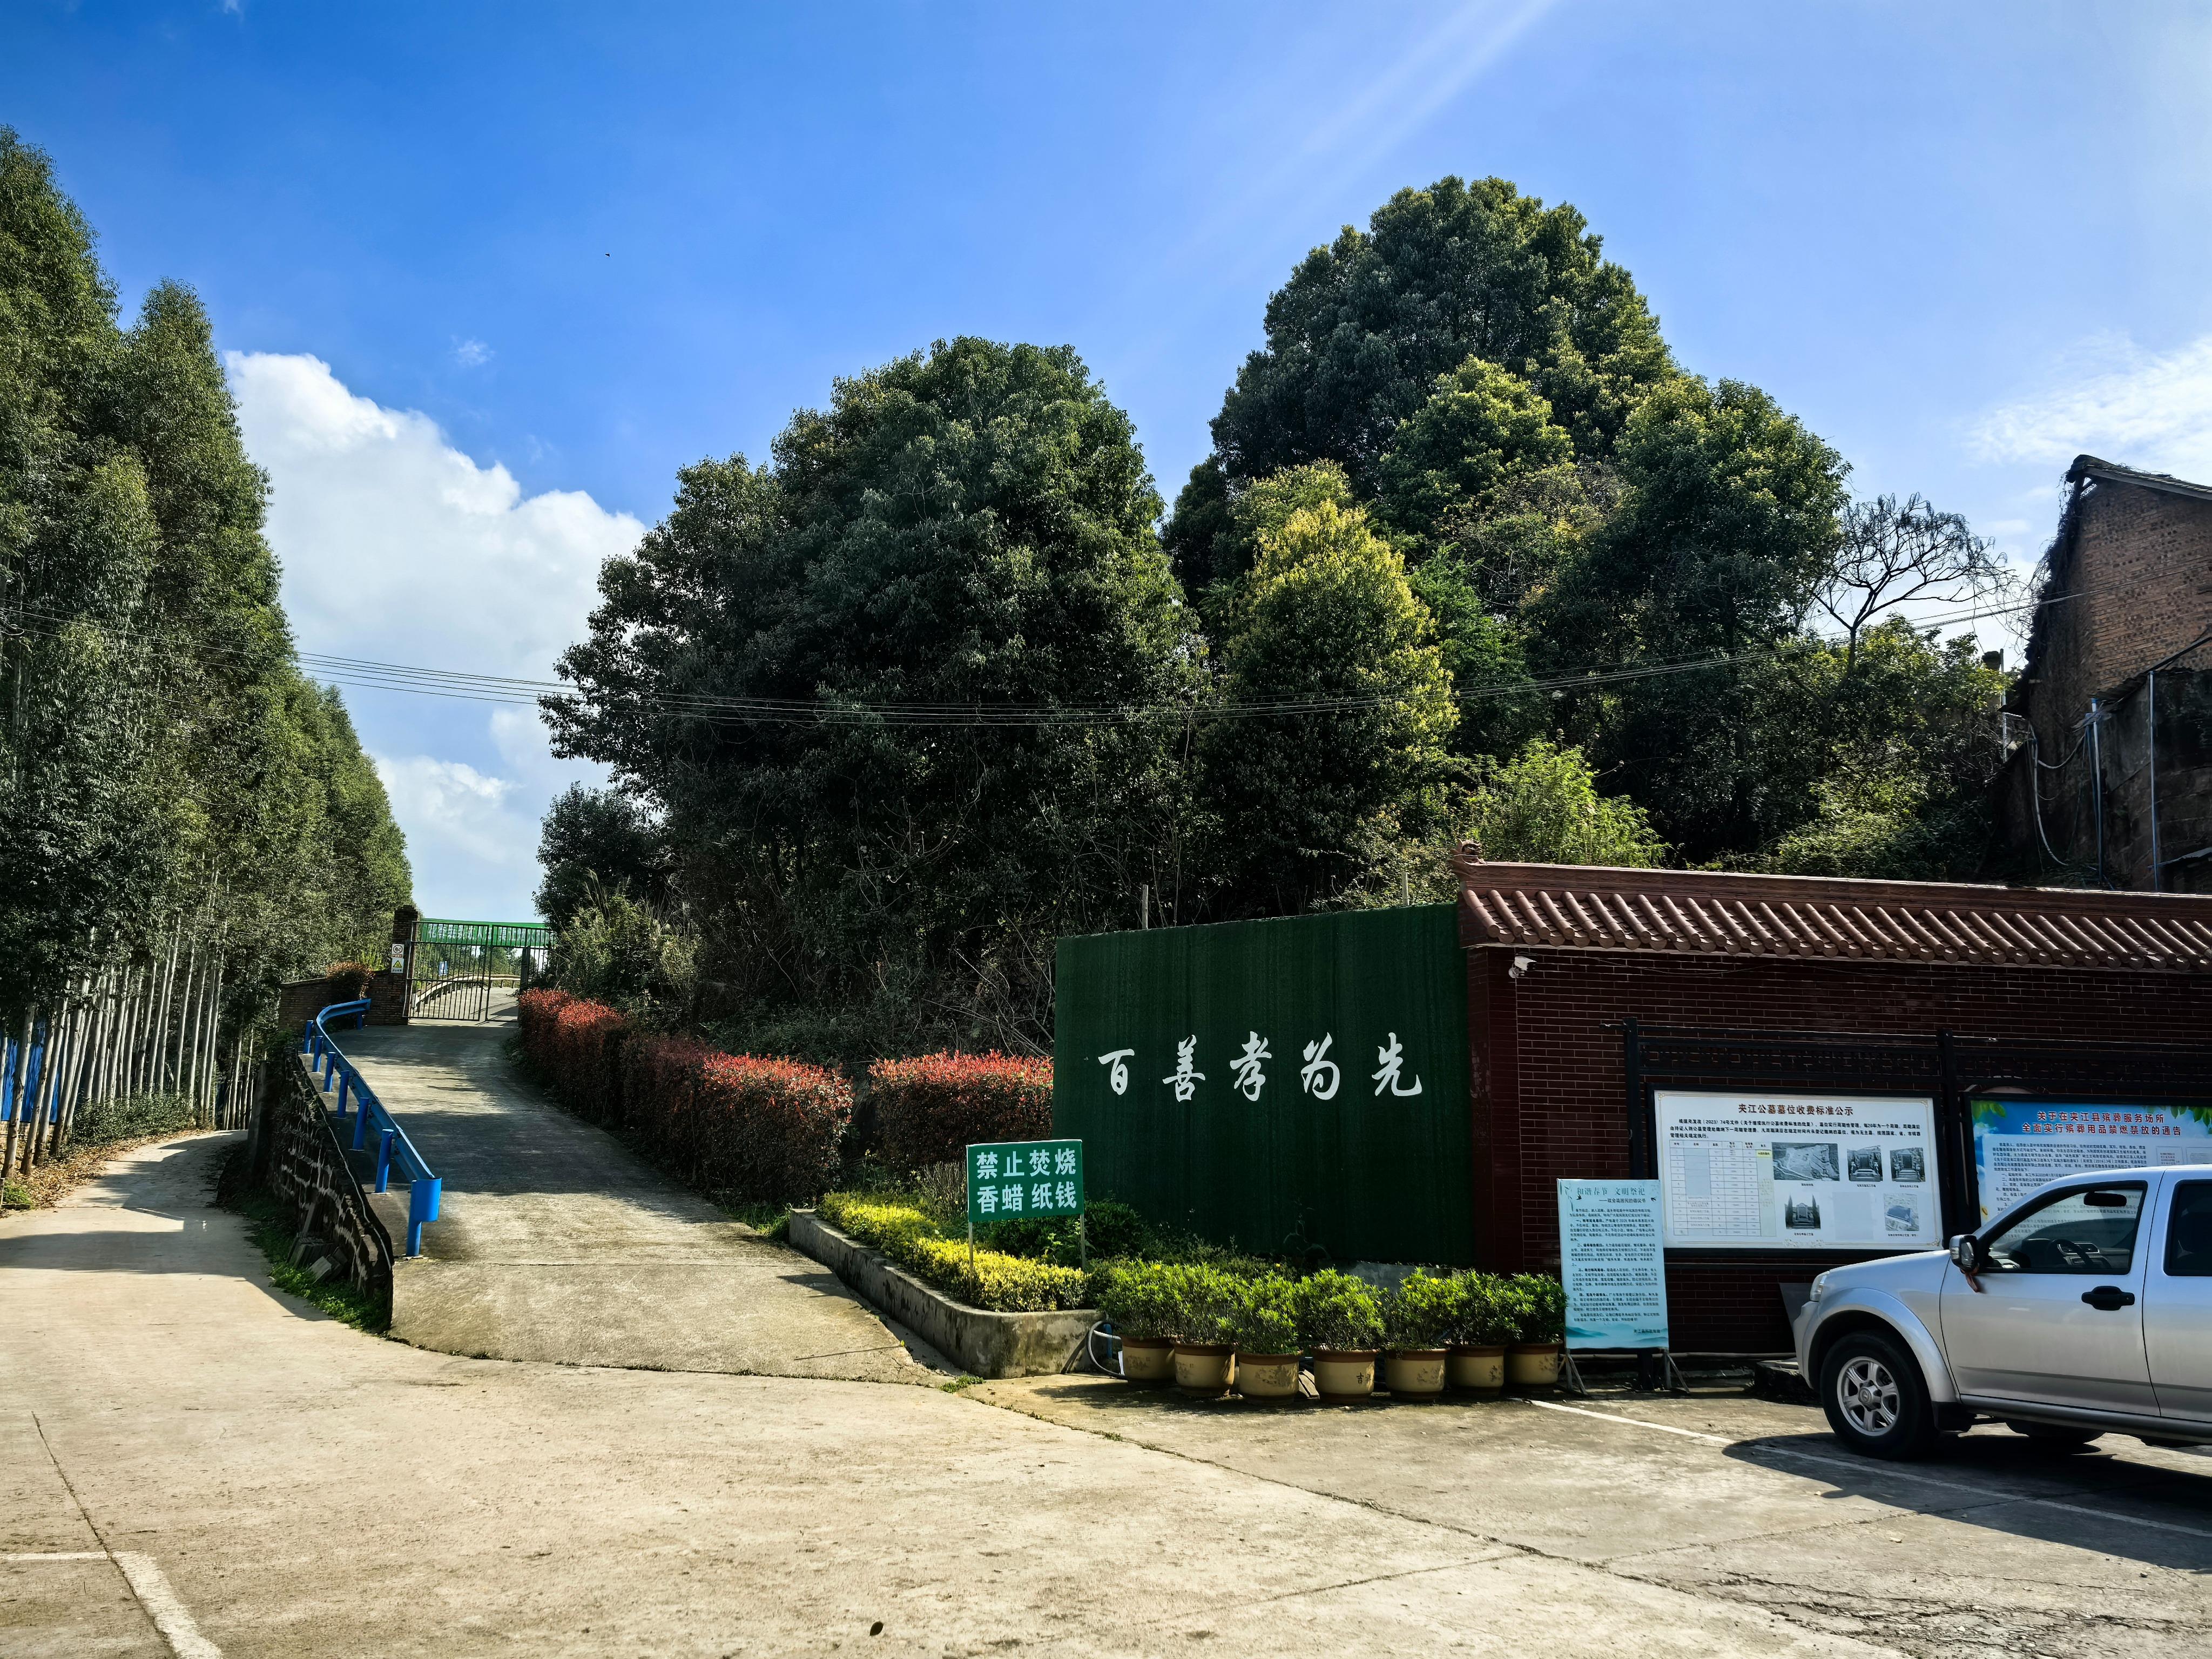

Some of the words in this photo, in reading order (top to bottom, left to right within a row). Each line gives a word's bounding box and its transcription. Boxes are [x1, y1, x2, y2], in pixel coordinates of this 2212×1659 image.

[1098, 1031, 1422, 1102] 百善孝为先
[1738, 1104, 1853, 1116] 夹江公墓墓位收费标准公示
[2036, 1110, 2164, 1123] 关于在夹江县殡葬服务场所
[2022, 1123, 2181, 1136] 全面实行殡葬用品禁燃禁放的通告
[976, 1148, 1076, 1179] 禁止焚烧
[977, 1181, 1077, 1213] 香蜡纸钱
